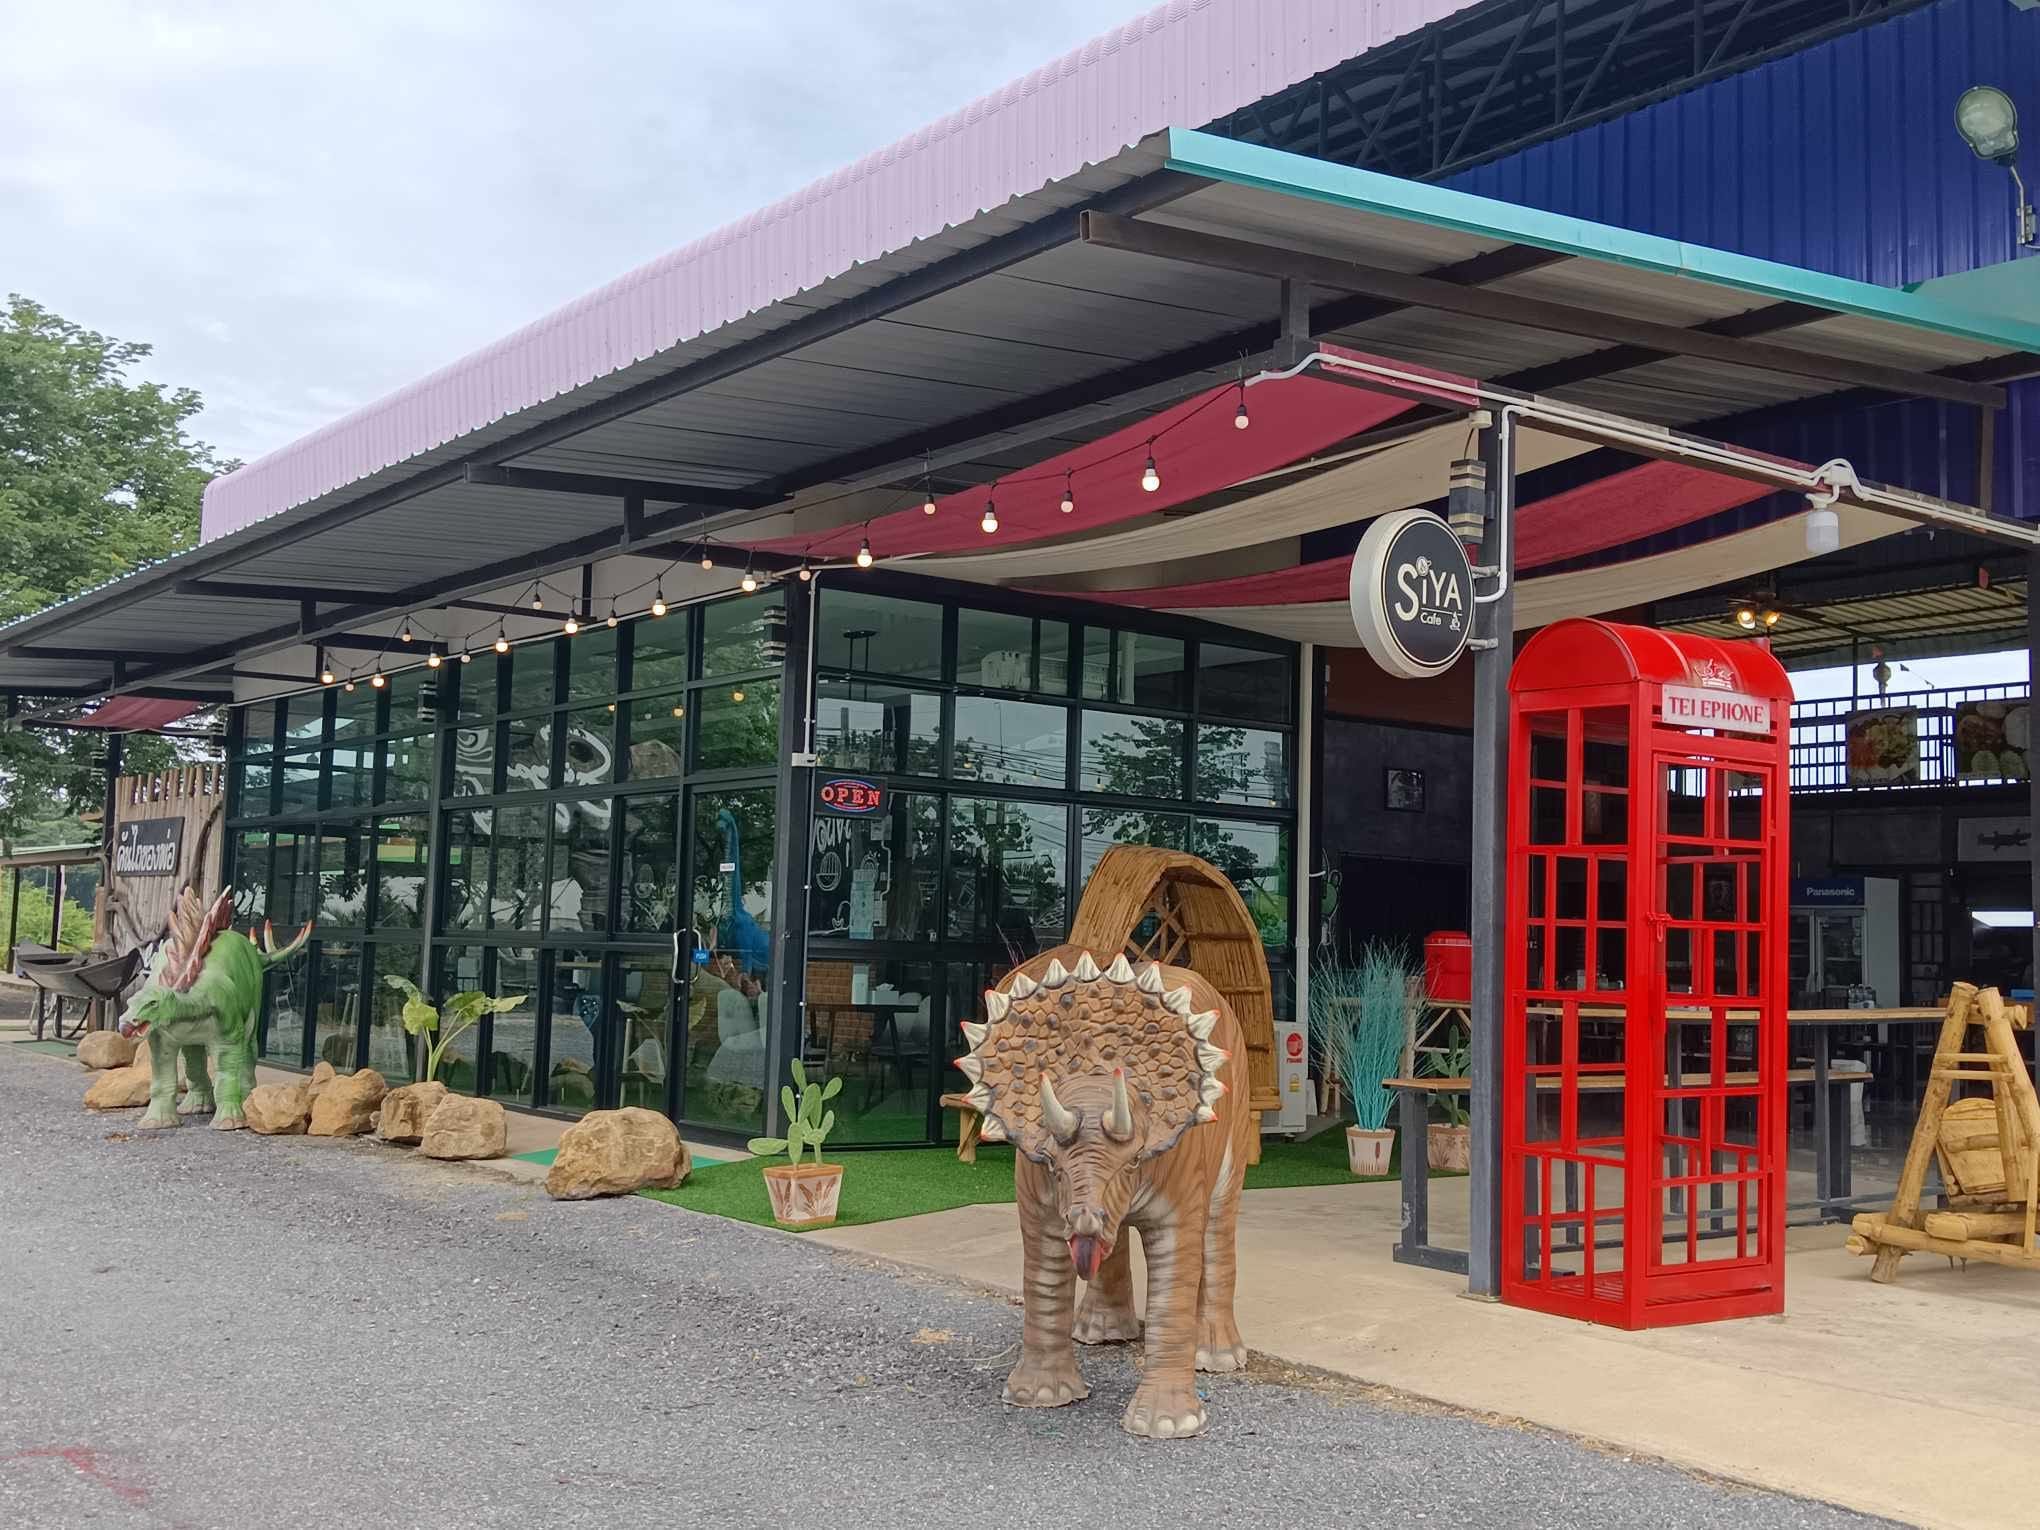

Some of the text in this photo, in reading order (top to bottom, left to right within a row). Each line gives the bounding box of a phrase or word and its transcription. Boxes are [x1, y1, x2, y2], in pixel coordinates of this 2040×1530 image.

[1420, 612, 1442, 626] Cafe
[1668, 696, 1764, 724] TELEPHONE
[821, 786, 880, 806] OPEN
[1806, 887, 1855, 897] Panasonic
